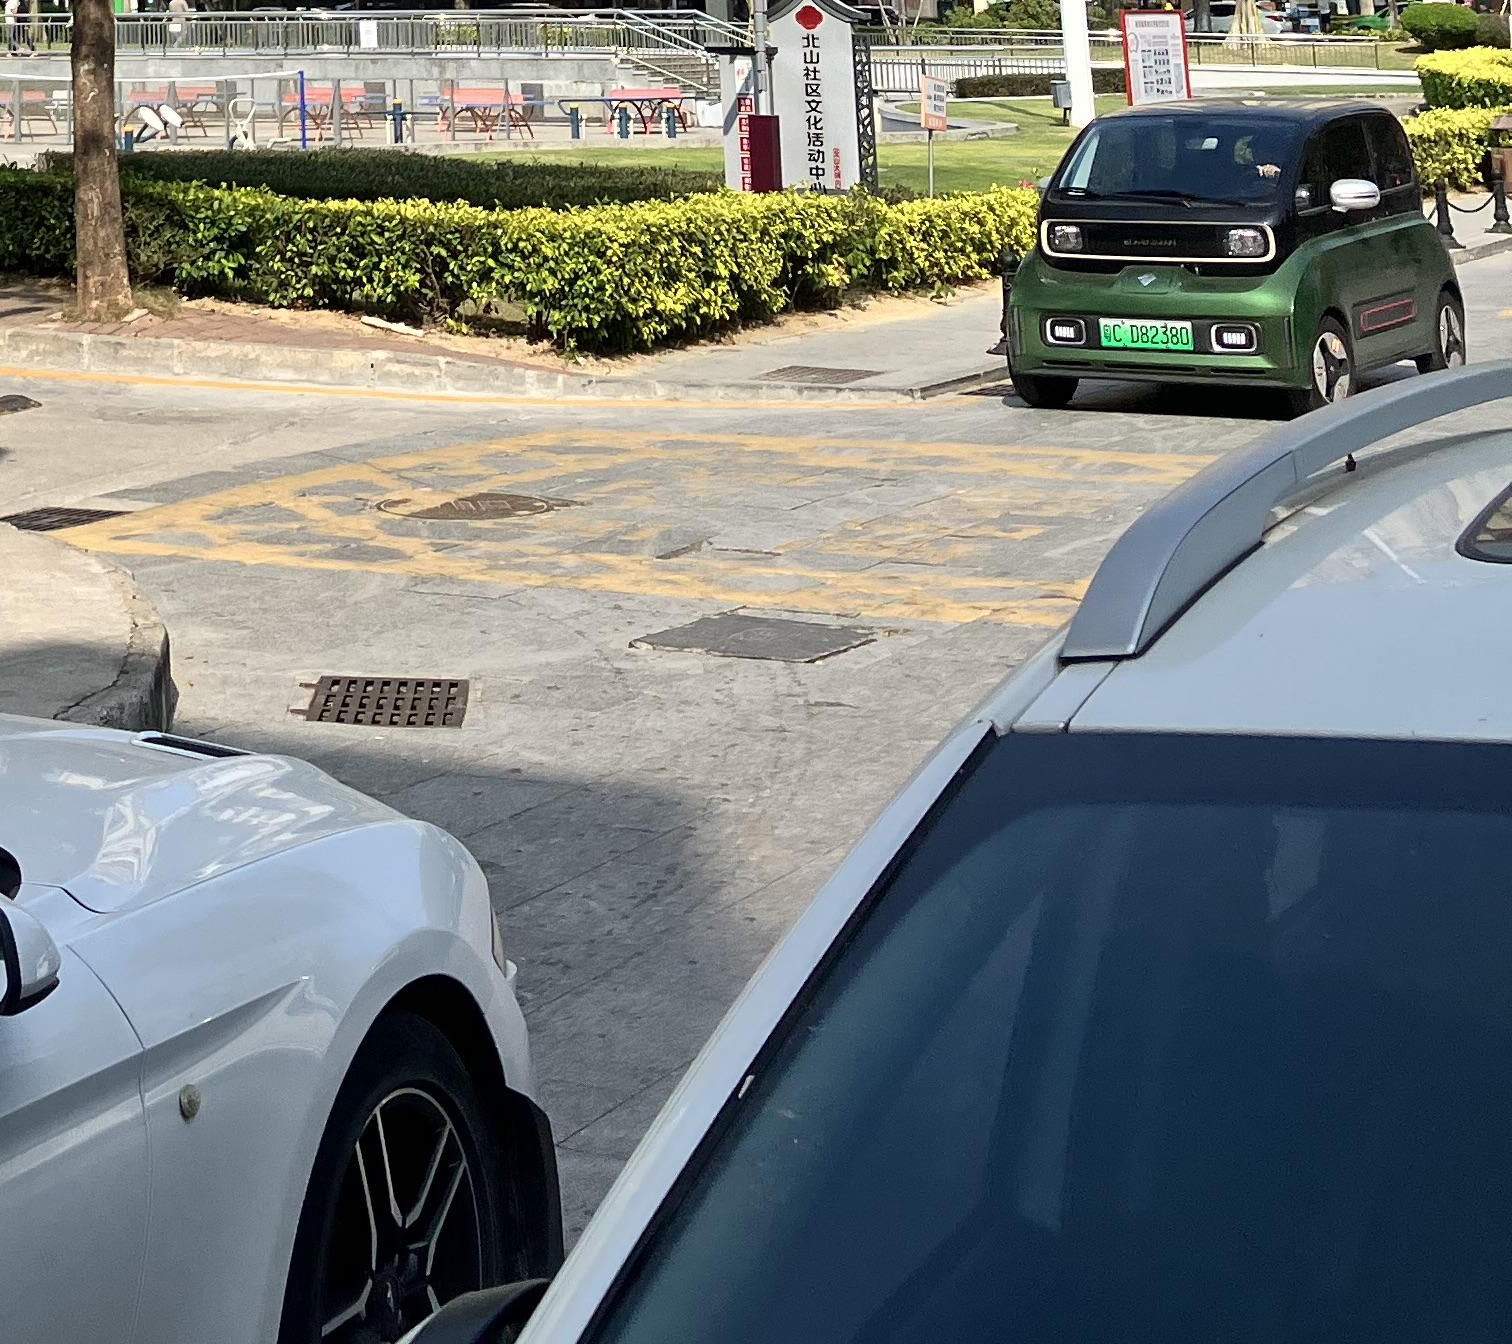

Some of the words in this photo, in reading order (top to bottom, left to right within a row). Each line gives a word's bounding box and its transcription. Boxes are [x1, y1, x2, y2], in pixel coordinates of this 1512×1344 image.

[801, 34, 827, 195] 北山社区文化活动中心
